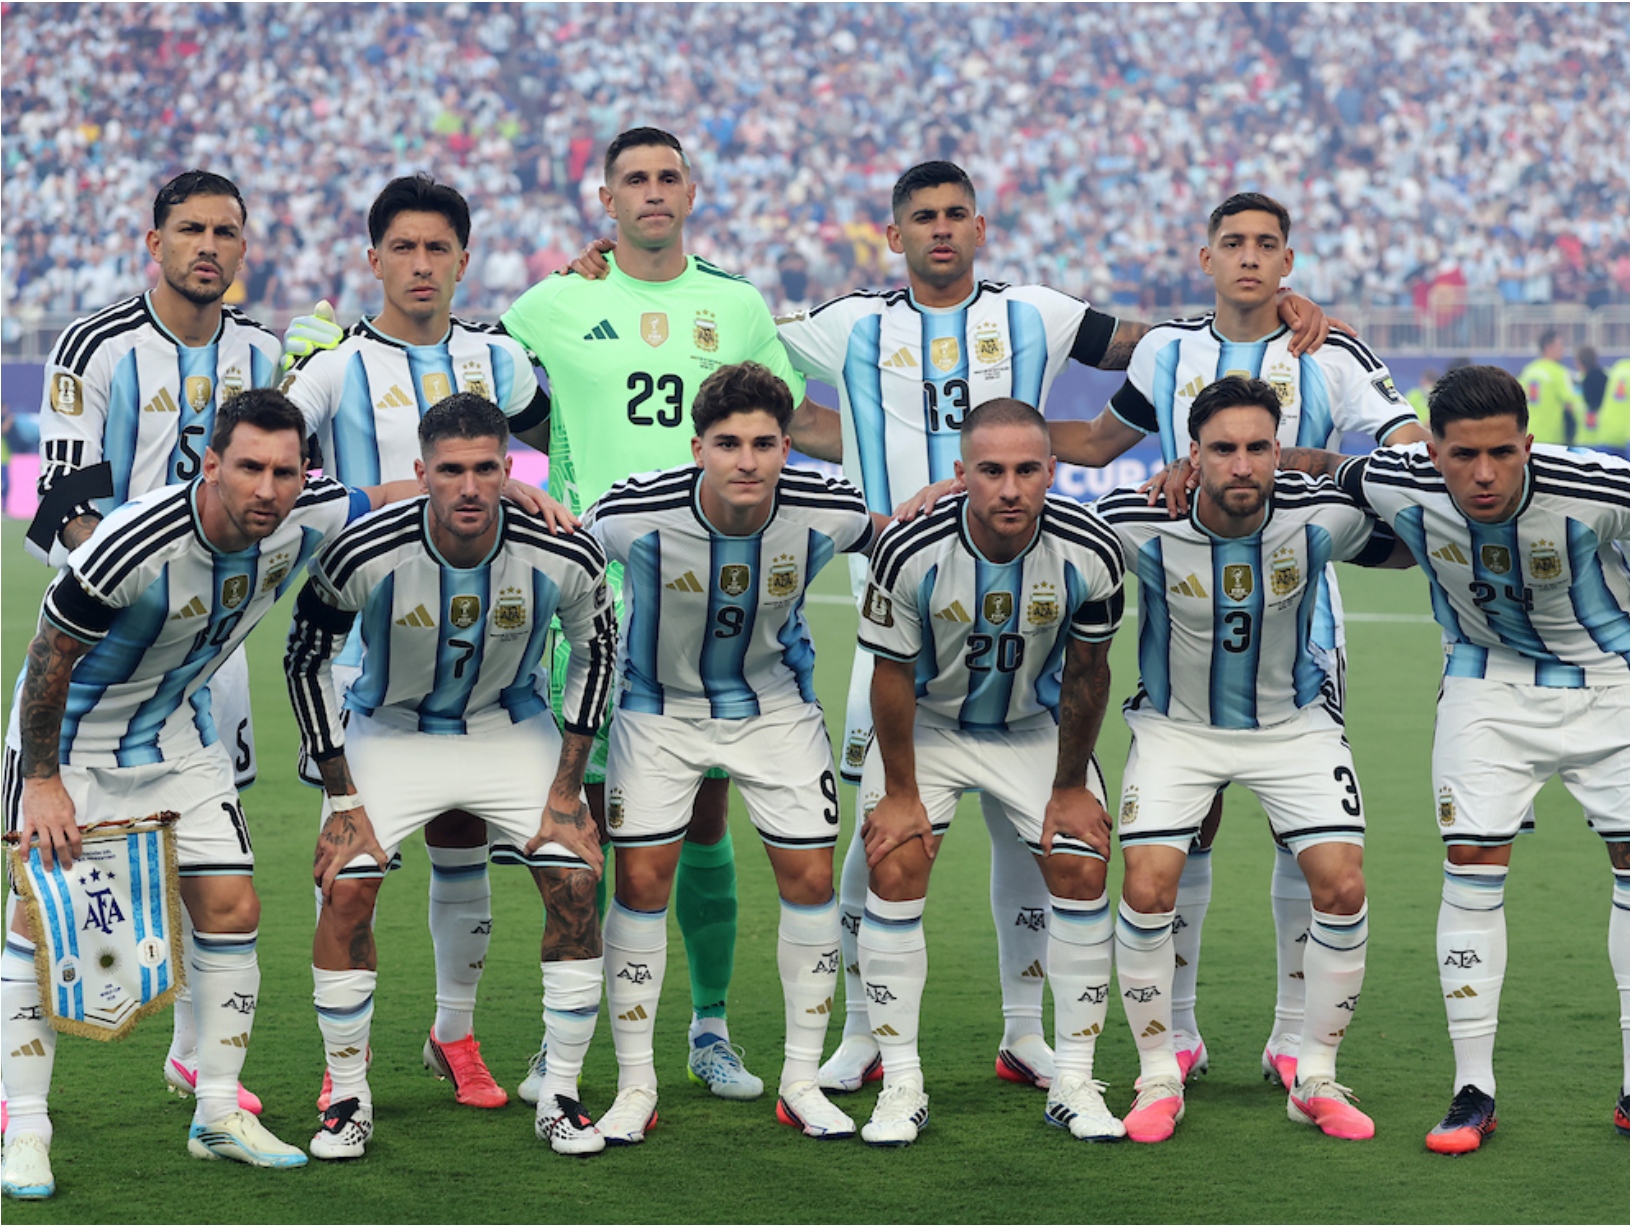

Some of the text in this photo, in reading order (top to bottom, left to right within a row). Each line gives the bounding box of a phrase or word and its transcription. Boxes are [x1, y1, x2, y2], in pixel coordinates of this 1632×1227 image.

[627, 371, 683, 428] 23
[922, 378, 968, 433] 13
[176, 425, 205, 481] 5
[1468, 579, 1534, 616] 24
[192, 611, 244, 651] 10
[714, 605, 745, 639] 9
[1222, 610, 1251, 653] 3
[448, 638, 475, 679] 7
[965, 632, 1025, 673] 20
[819, 771, 839, 825] 9
[1333, 764, 1361, 817] 3
[82, 888, 125, 934] AFA
[1015, 907, 1046, 931] AFA
[617, 961, 652, 984] AFA
[1445, 949, 1482, 968] AFA
[10, 1005, 42, 1020] AF
[1124, 986, 1161, 1003] AFA
